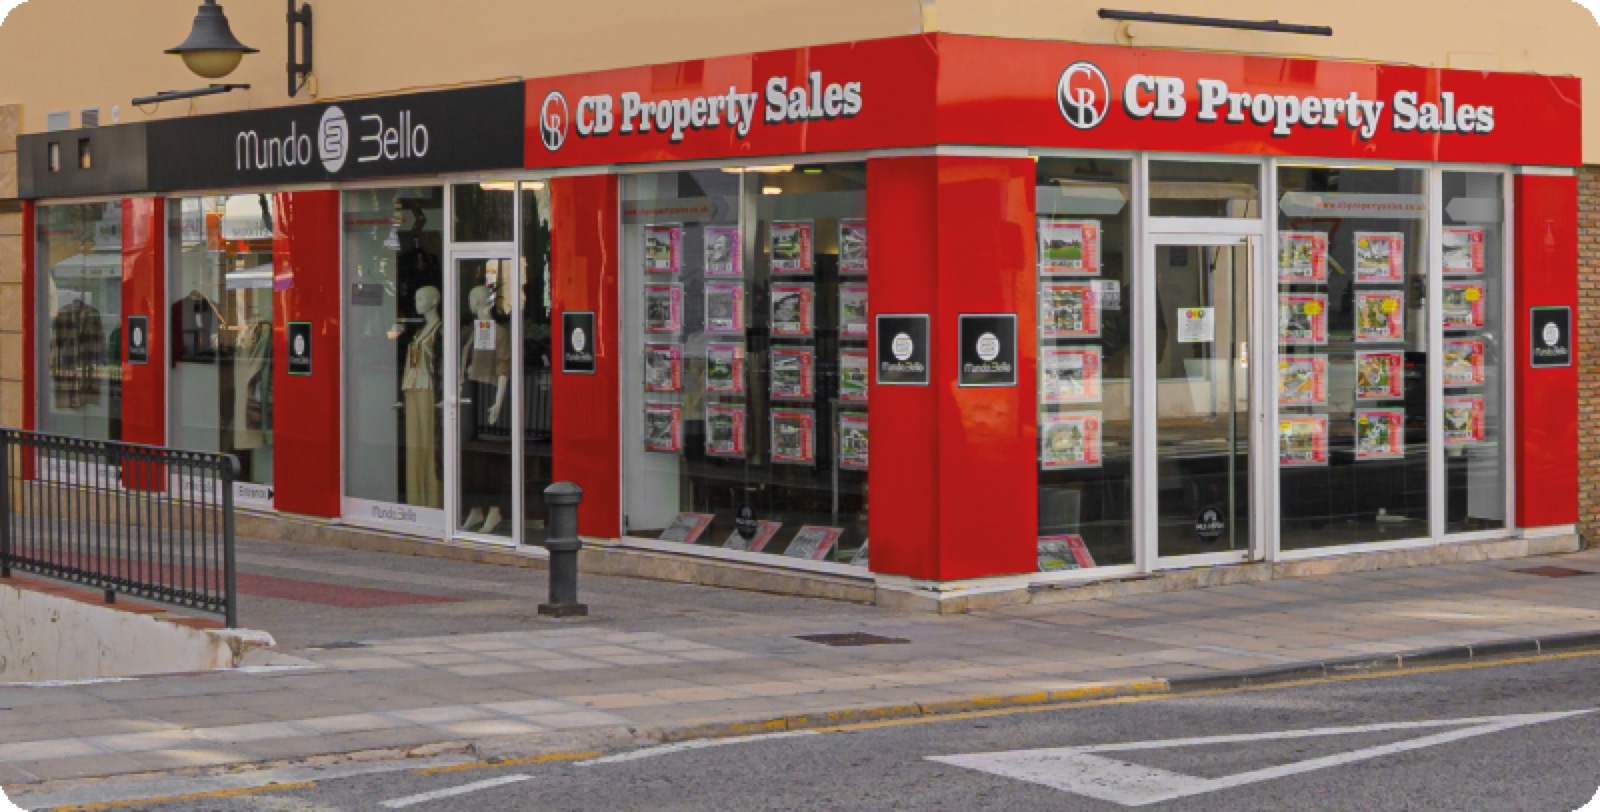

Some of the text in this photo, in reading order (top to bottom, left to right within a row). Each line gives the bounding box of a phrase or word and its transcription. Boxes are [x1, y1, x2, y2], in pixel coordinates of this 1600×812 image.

[575, 71, 862, 144] CB Property Sales
[1122, 73, 1495, 140] CB Property Sales
